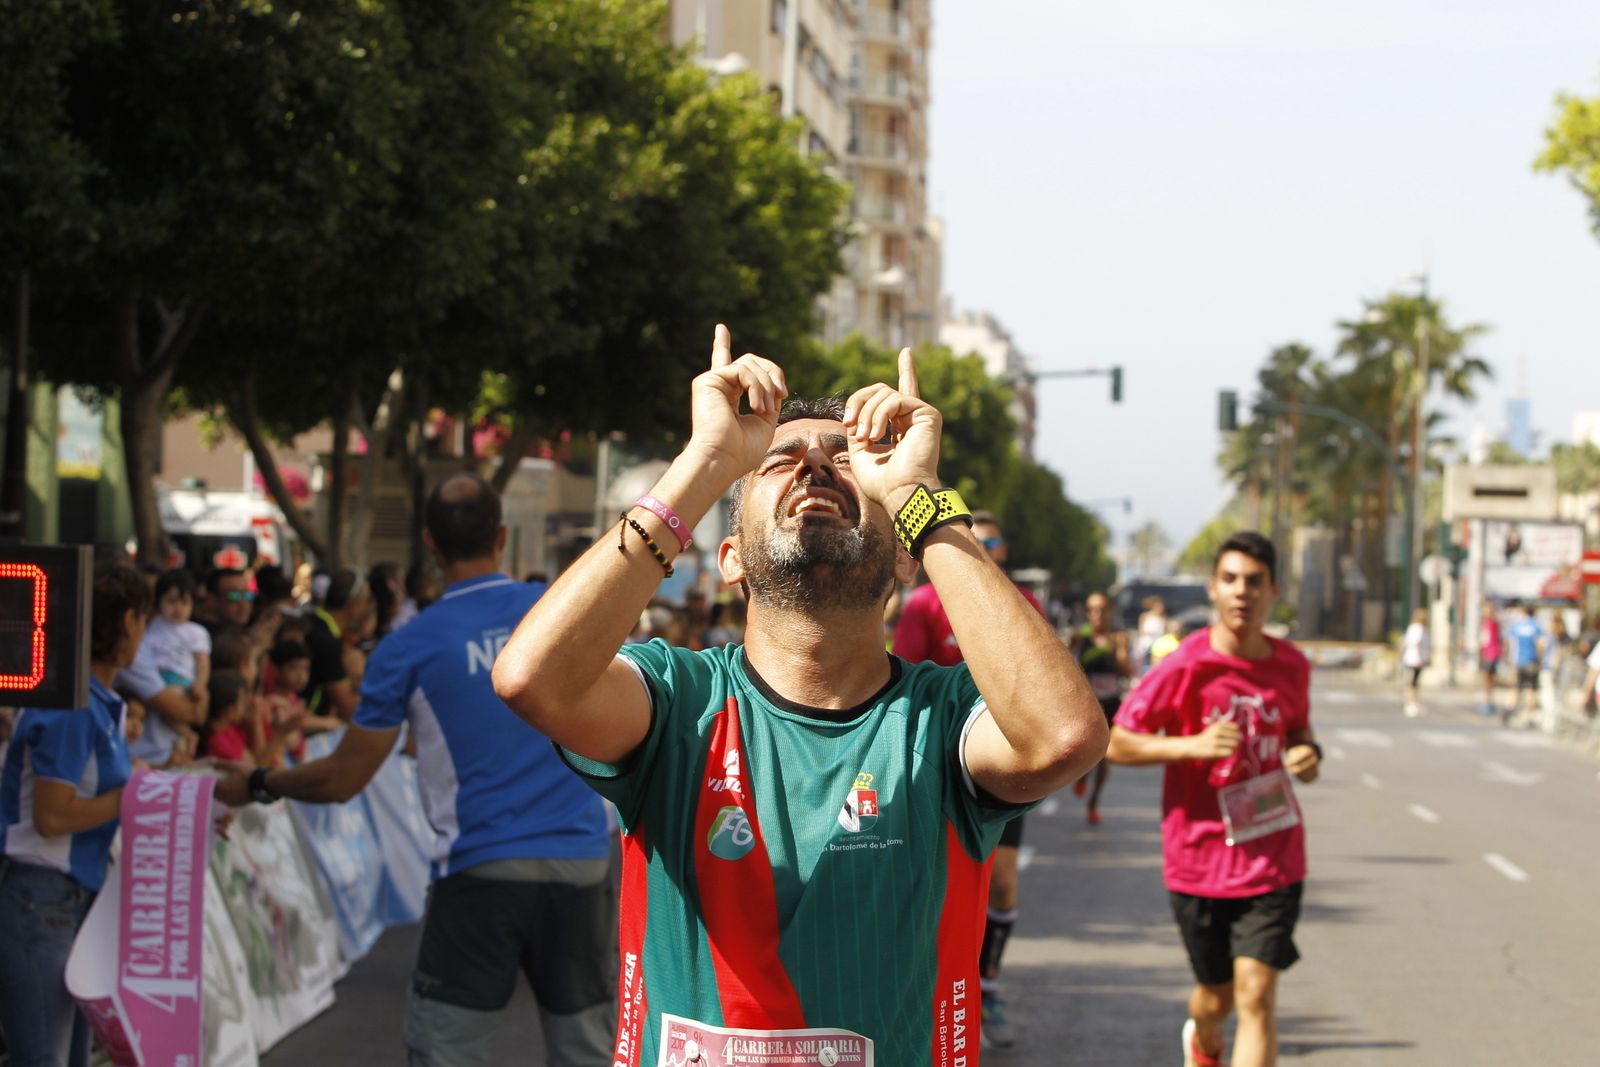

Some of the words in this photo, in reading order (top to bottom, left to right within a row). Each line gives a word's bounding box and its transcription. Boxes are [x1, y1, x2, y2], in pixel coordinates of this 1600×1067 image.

[128, 811, 172, 976] CARRERA
[171, 904, 190, 936] LAS
[169, 940, 189, 974] POR
[633, 976, 644, 1005] Torre
[953, 978, 966, 1006] EL
[617, 1028, 630, 1059] DE
[624, 952, 637, 1027] JAVIER
[633, 1009, 638, 1020] la
[632, 1022, 637, 1037] de
[953, 1007, 966, 1053] BAR
[733, 1039, 794, 1055] CARRERA
[734, 1054, 749, 1063] POR
[749, 1055, 760, 1063] LAS
